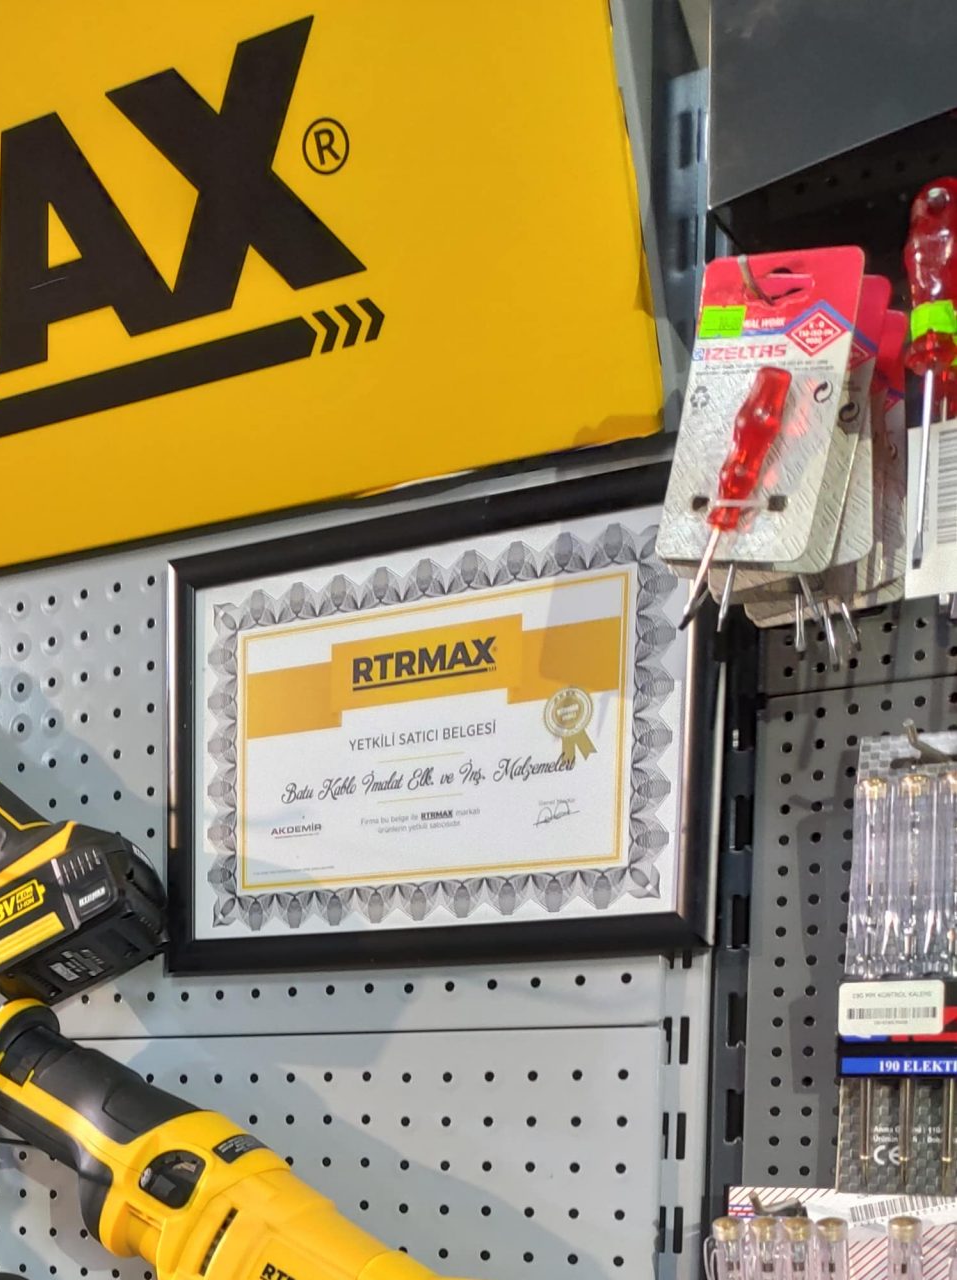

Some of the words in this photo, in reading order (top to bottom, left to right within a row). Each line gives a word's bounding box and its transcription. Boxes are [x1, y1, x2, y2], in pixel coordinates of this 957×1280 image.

[352, 636, 497, 687] RTRMAX
[349, 732, 396, 751] YETKİLİ
[399, 728, 439, 746] SATICI
[442, 719, 497, 741] BELGESİ
[281, 782, 314, 804] Batu
[318, 775, 357, 801] Kablo
[439, 772, 455, 786] ve
[420, 809, 453, 820] RTRMAX
[878, 1059, 900, 1073] 190
[903, 1059, 957, 1073] ELEKT
